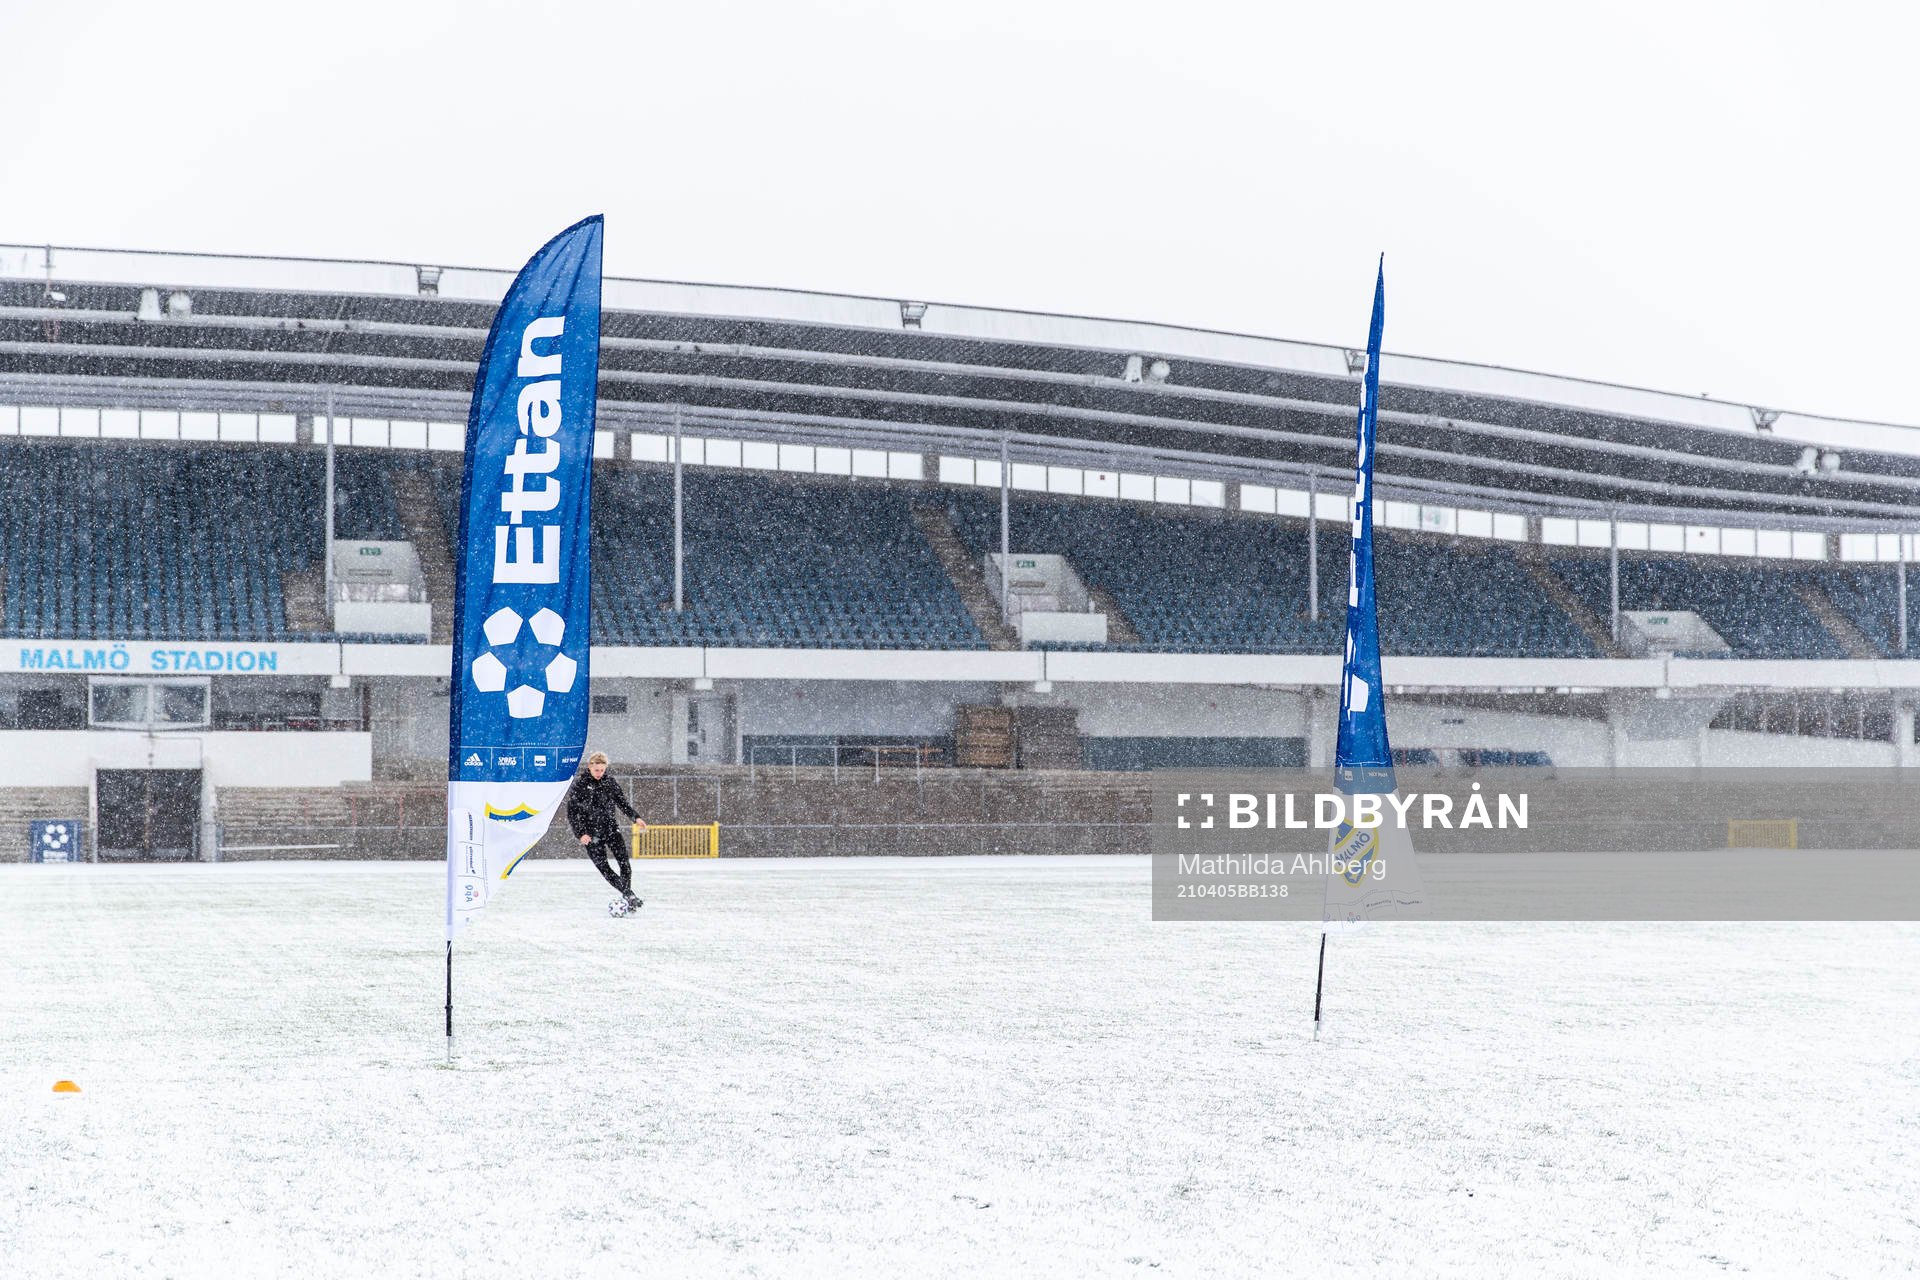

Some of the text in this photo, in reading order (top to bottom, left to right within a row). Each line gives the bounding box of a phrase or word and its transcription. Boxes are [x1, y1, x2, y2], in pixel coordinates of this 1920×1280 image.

[493, 316, 565, 584] Ettan
[20, 644, 278, 671] MALMÖ STADION
[1335, 831, 1370, 866] MALMÖ
